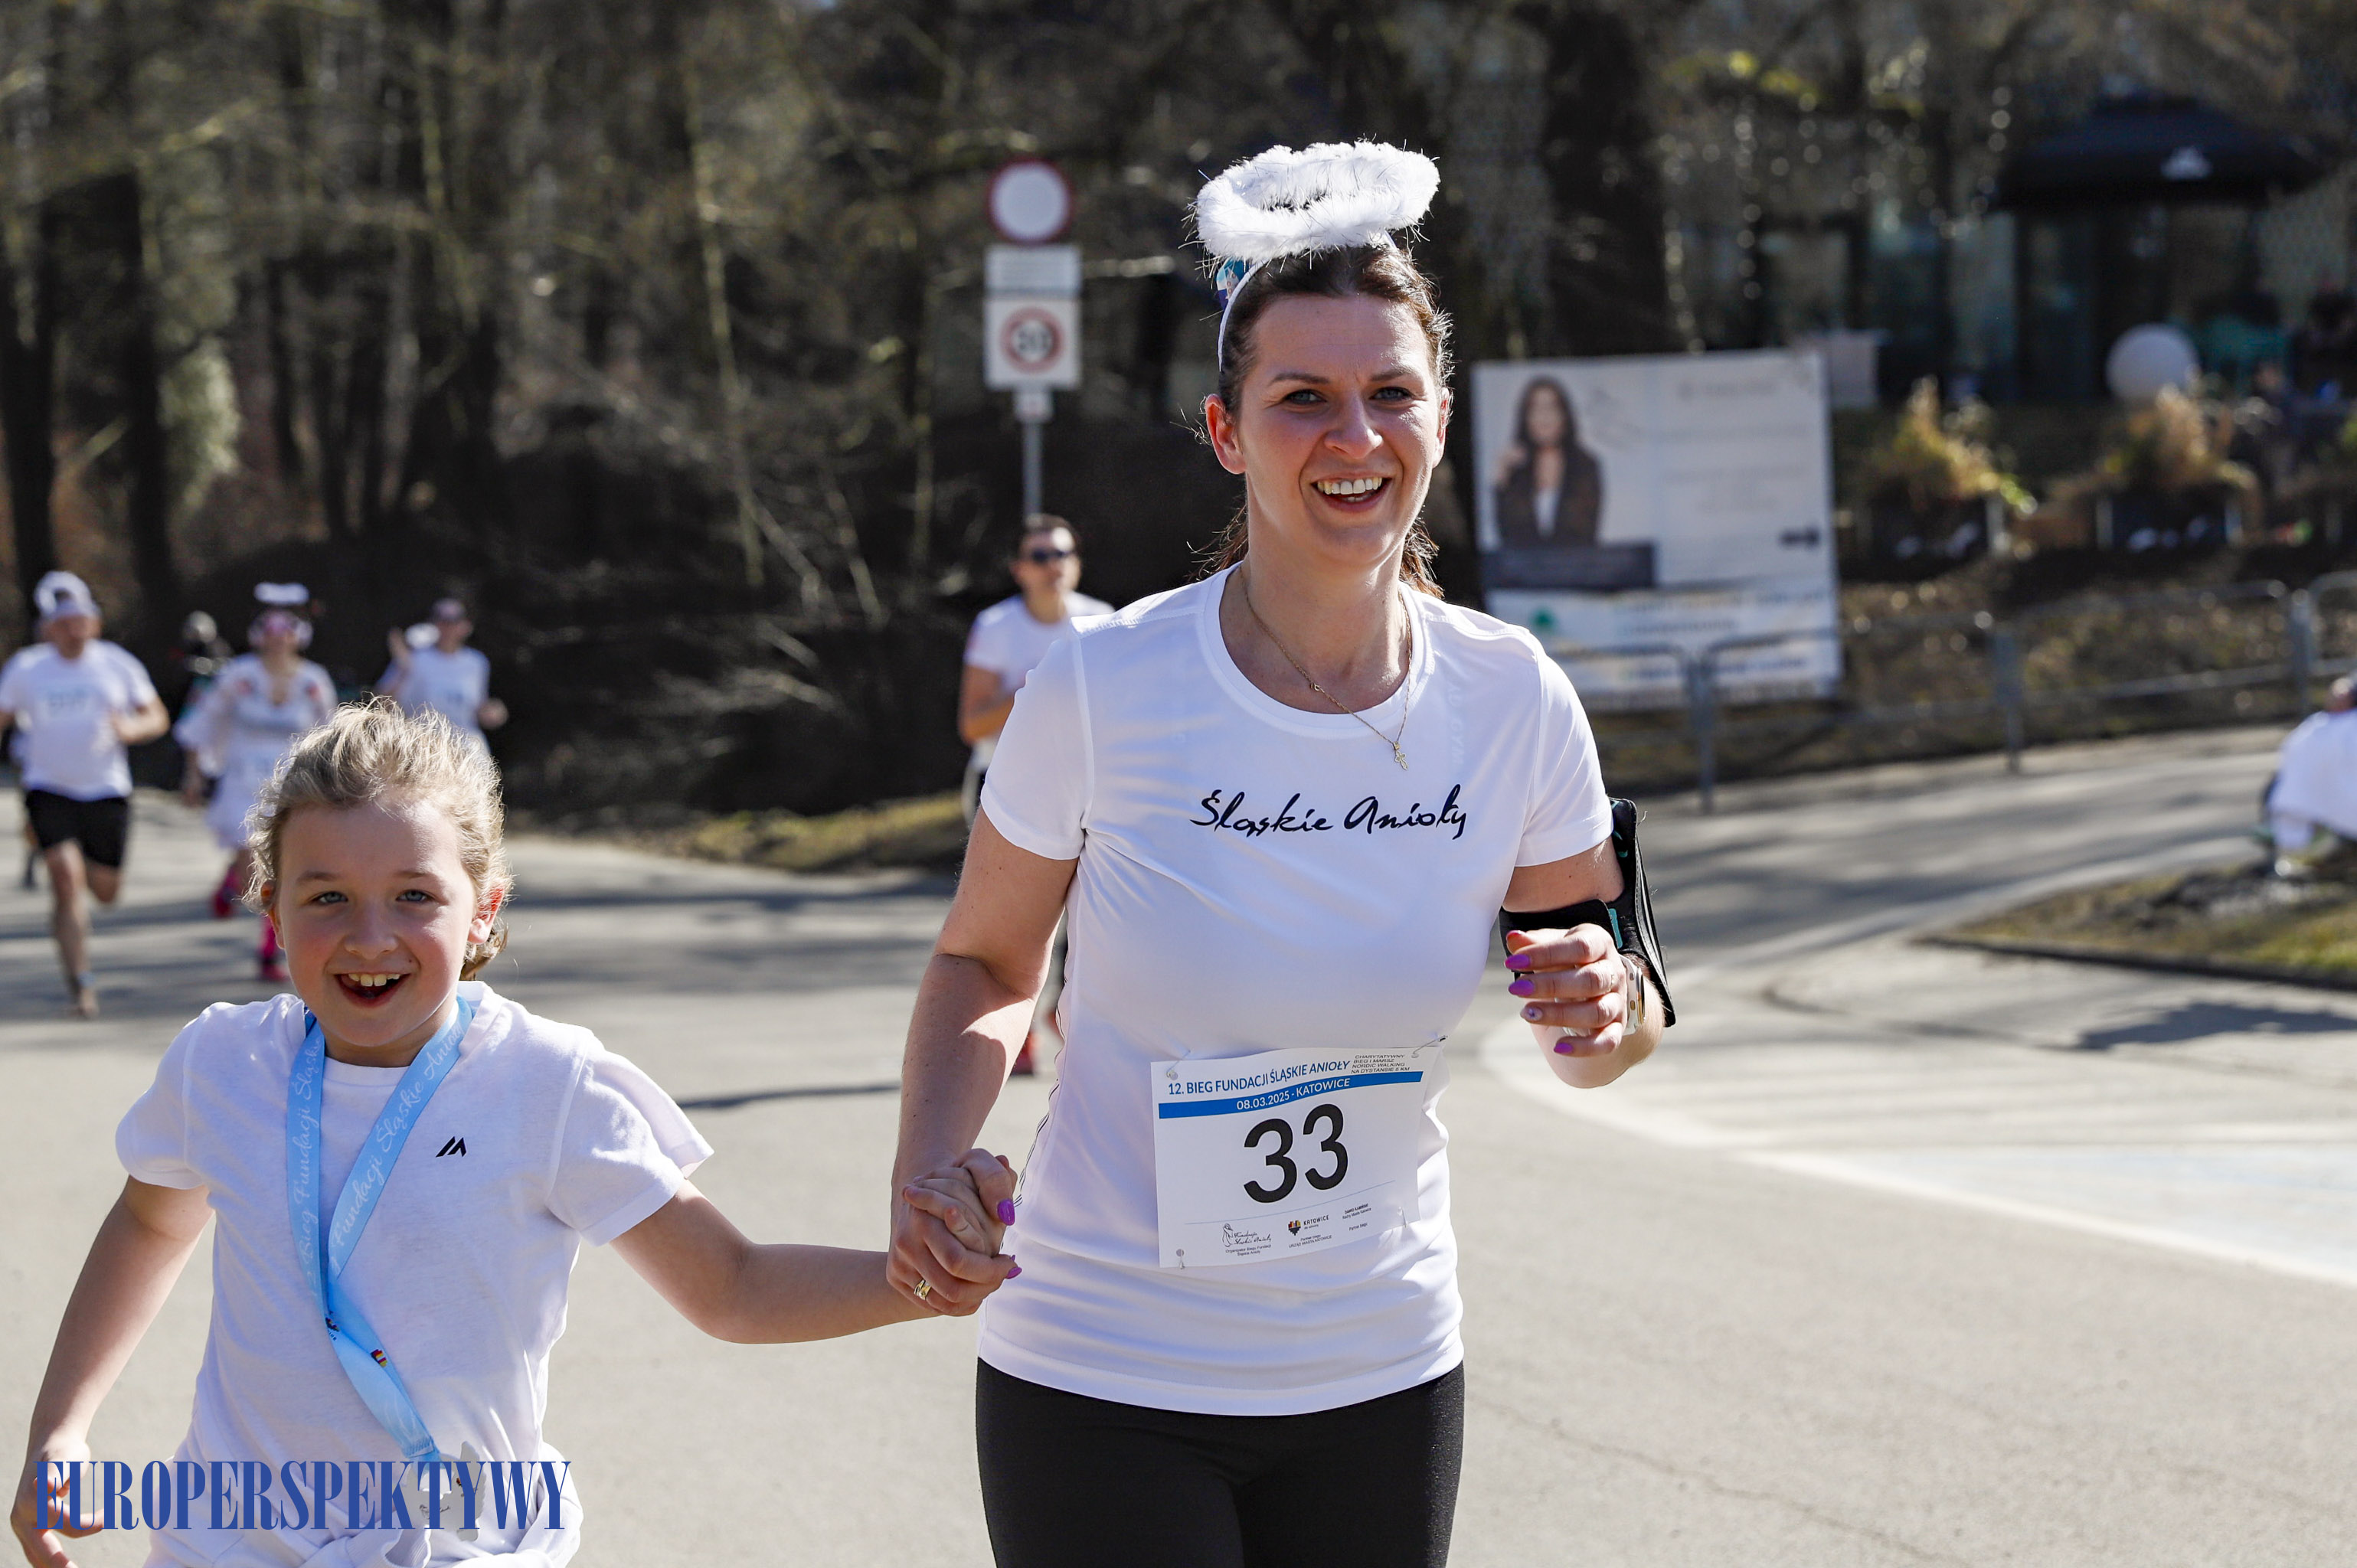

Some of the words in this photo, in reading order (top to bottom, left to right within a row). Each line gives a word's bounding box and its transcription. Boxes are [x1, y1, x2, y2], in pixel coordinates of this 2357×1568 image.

[1169, 1083, 1185, 1095] 12.
[1186, 1081, 1213, 1094] BIEG
[1215, 1073, 1269, 1093] FUNDACJI
[1270, 1063, 1307, 1083] ŚLĄSKIE
[1309, 1060, 1351, 1074] ANIOŁY
[1237, 1090, 1290, 1110] 08.03.2025
[1296, 1078, 1351, 1098] KATOWICE
[292, 1105, 319, 1204] Fundacji
[1244, 1103, 1348, 1203] 33
[1303, 1214, 1329, 1225] KATOWICE
